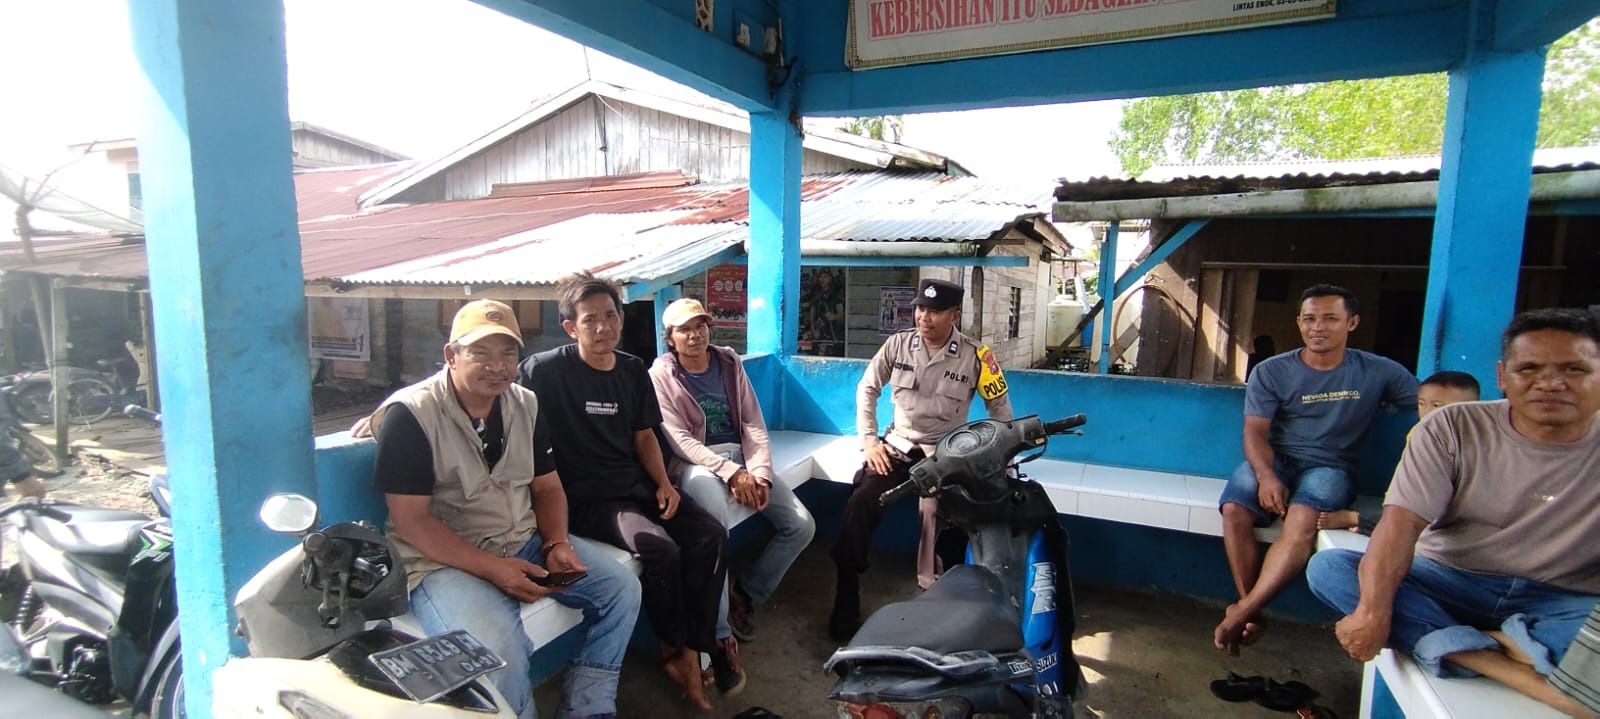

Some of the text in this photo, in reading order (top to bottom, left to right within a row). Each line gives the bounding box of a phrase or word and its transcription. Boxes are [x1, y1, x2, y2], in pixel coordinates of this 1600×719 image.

[1232, 1, 1254, 11] LINTAS
[870, 0, 994, 38] KEBERSIHAN
[943, 370, 969, 384] POLRI
[1302, 393, 1328, 401] NEVADA
[380, 654, 419, 679] BM
[1035, 652, 1058, 673] SUZUK
